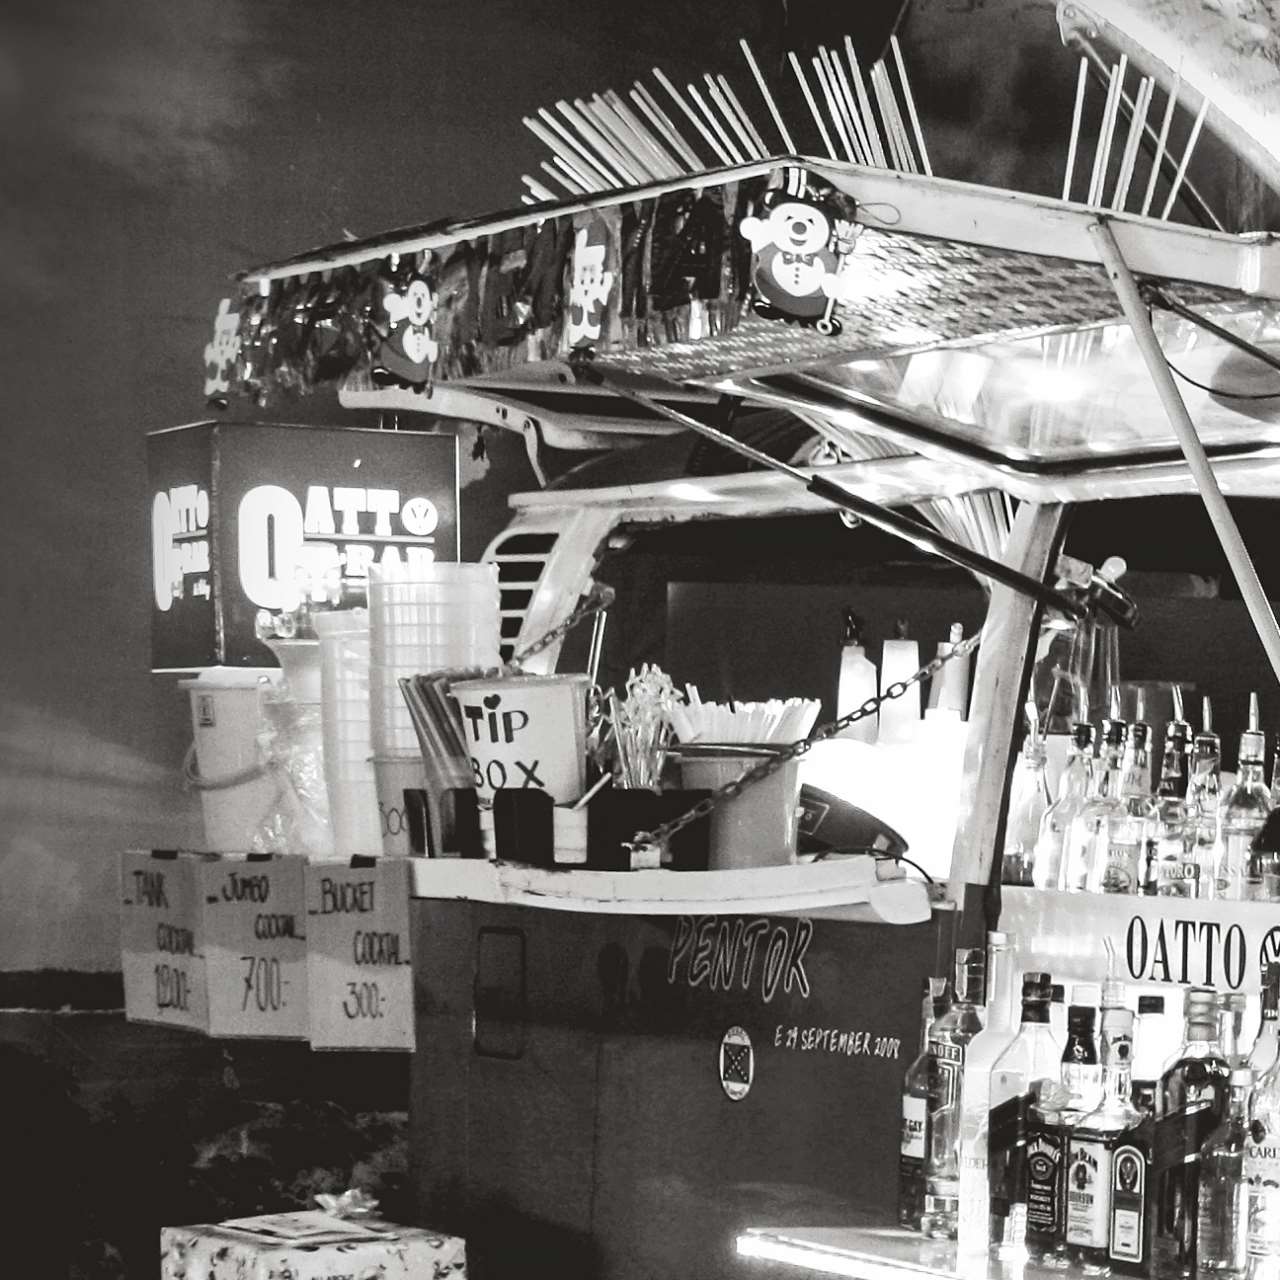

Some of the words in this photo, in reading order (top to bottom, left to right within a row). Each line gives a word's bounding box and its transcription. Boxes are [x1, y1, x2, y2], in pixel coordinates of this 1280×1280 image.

[320, 877, 376, 914] BUCKET
[1126, 915, 1247, 990] OATTO
[801, 1027, 871, 1057] SEPTEMBER
